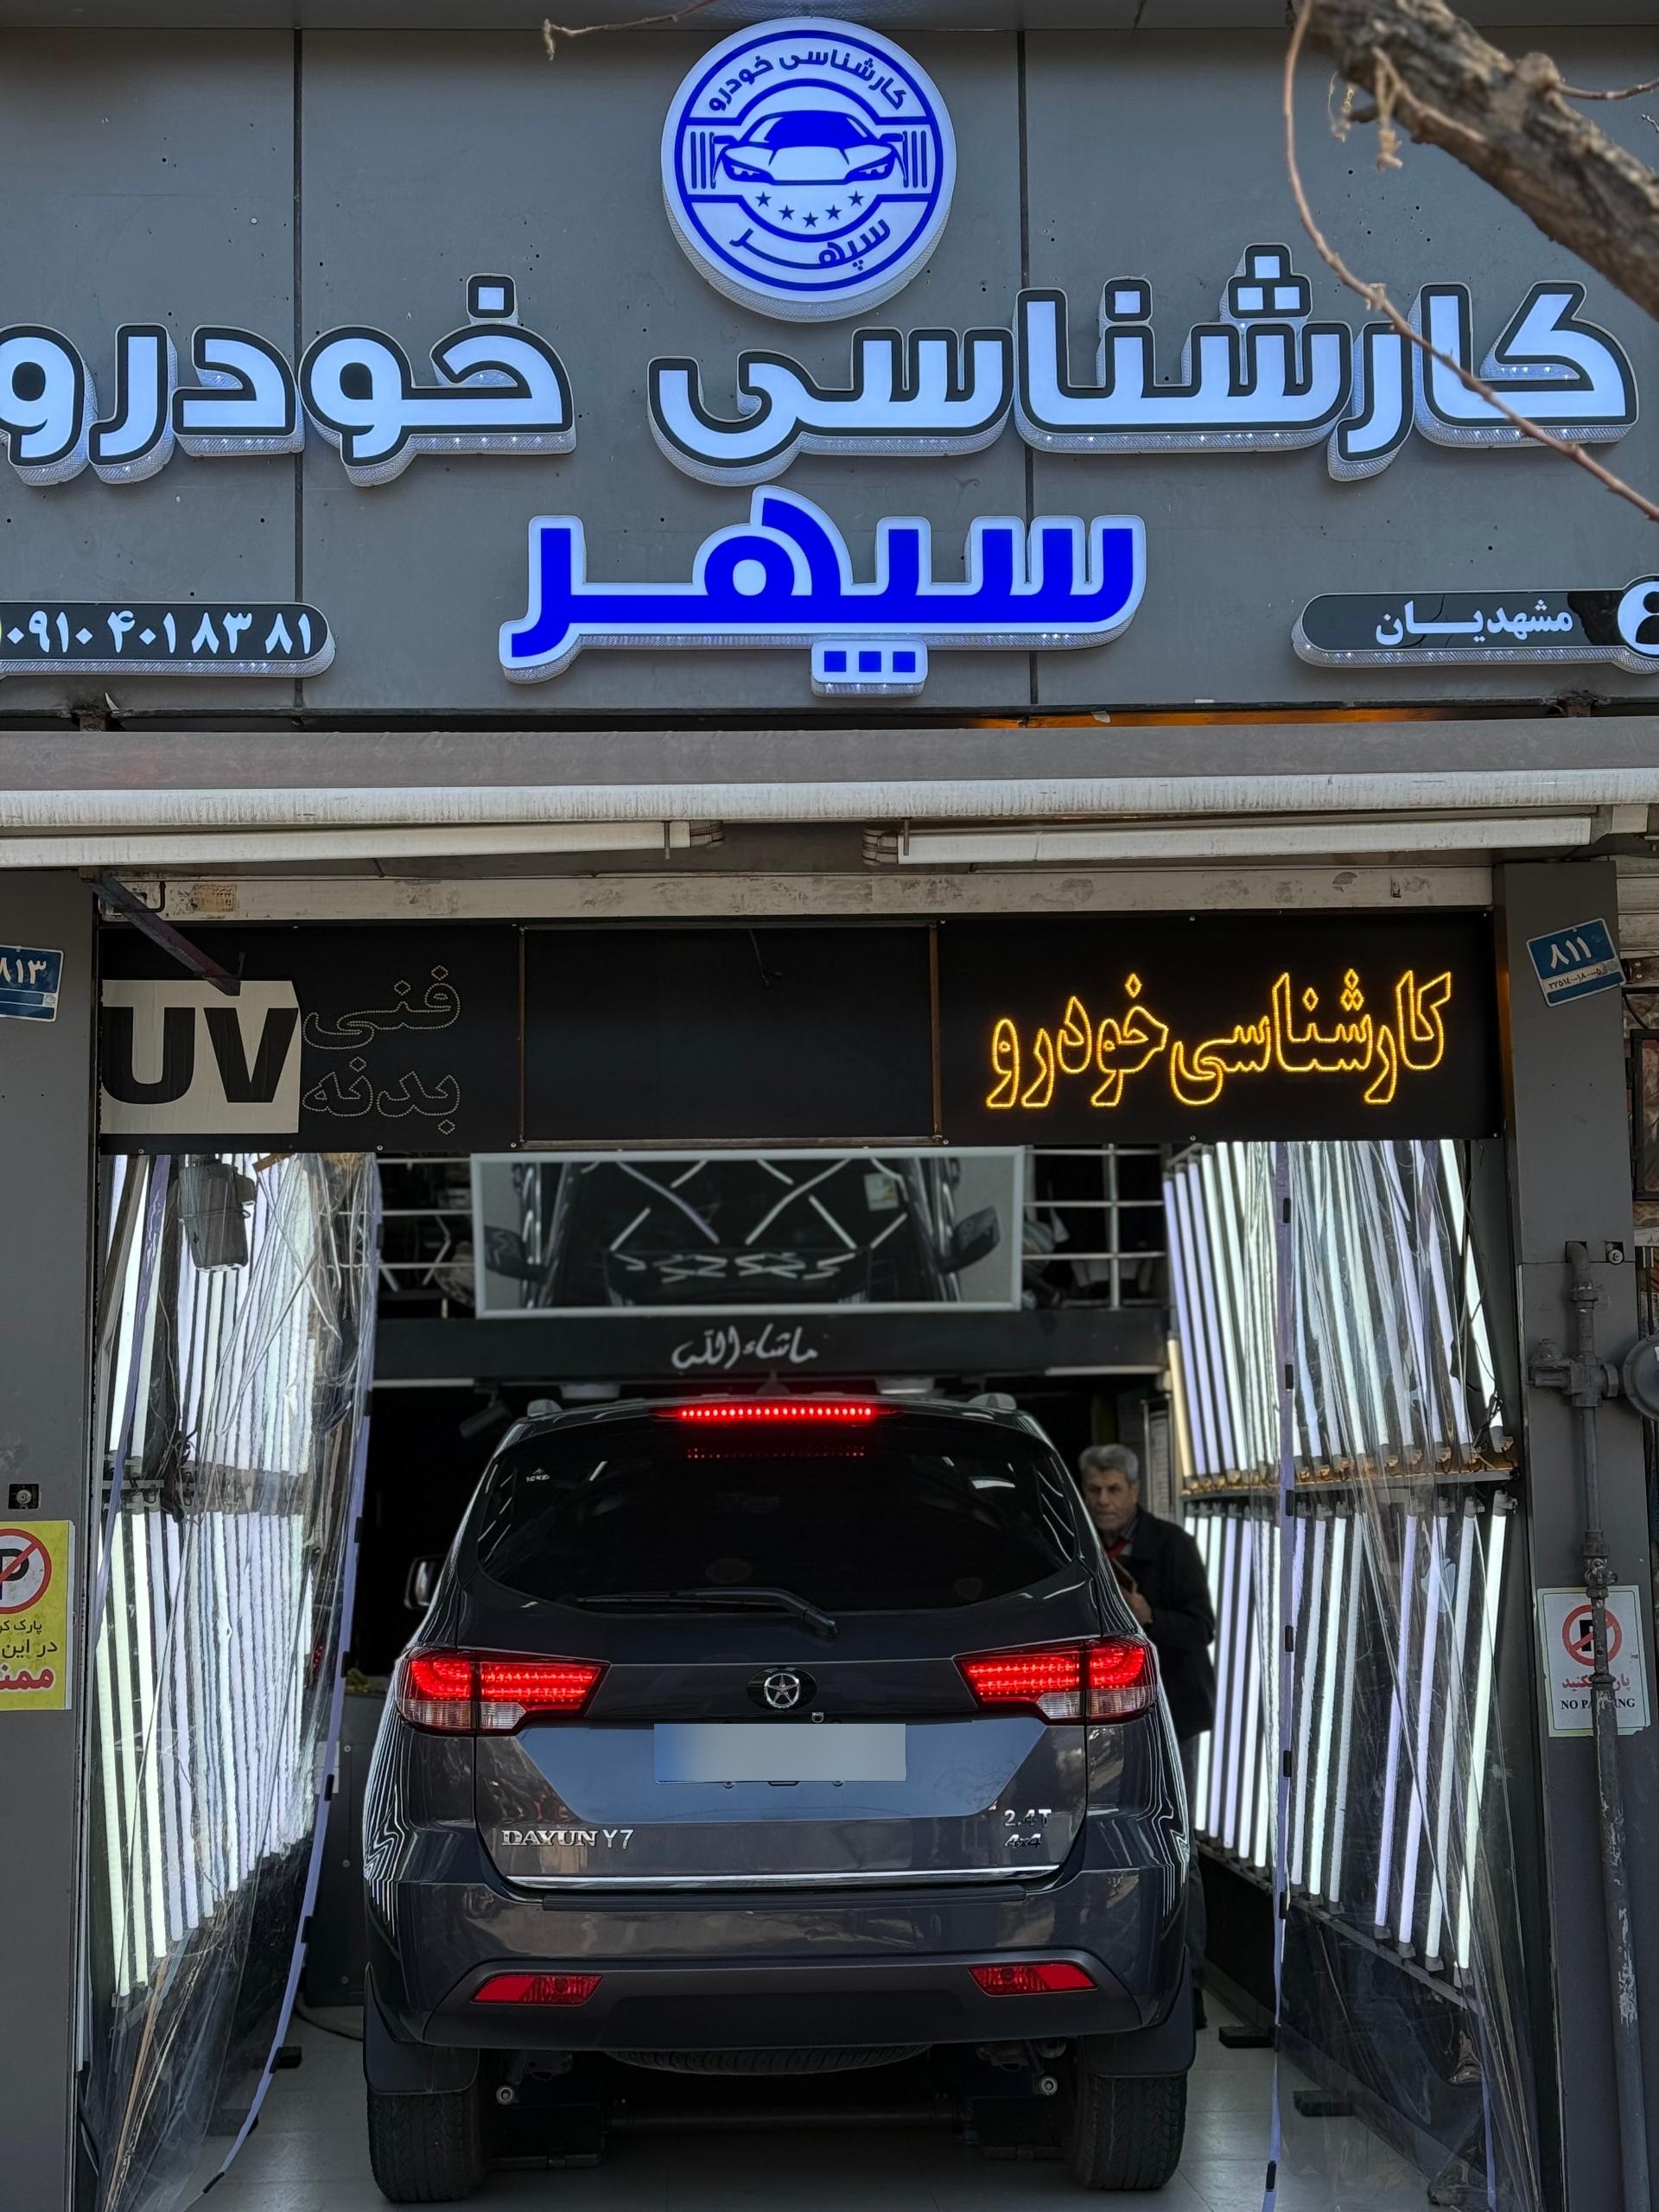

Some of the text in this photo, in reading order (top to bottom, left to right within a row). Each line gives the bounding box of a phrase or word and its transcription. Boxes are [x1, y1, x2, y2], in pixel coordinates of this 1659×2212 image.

[708, 49, 908, 112] کارشناسی خودرو
[728, 218, 892, 271] سپهر
[0, 249, 1633, 467] کارشناسی خودرو
[506, 493, 1139, 679] سپهر
[1375, 598, 1573, 646] مشهدیان
[1550, 936, 1592, 969] ۸۱۱
[302, 964, 461, 1050] فنی
[102, 1007, 300, 1104] UV
[985, 968, 1452, 1109] کارشناسی خودرو
[301, 1055, 461, 1136] بدنه
[2, 1638, 58, 1659] در این
[13, 1618, 42, 1635] پارک
[0, 1664, 54, 1690] ممن
[1561, 1674, 1594, 1692] کنید
[1560, 1700, 1579, 1710] NO
[501, 1828, 634, 1850] DAYUN Y7
[1004, 1808, 1052, 1827] 2.4T
